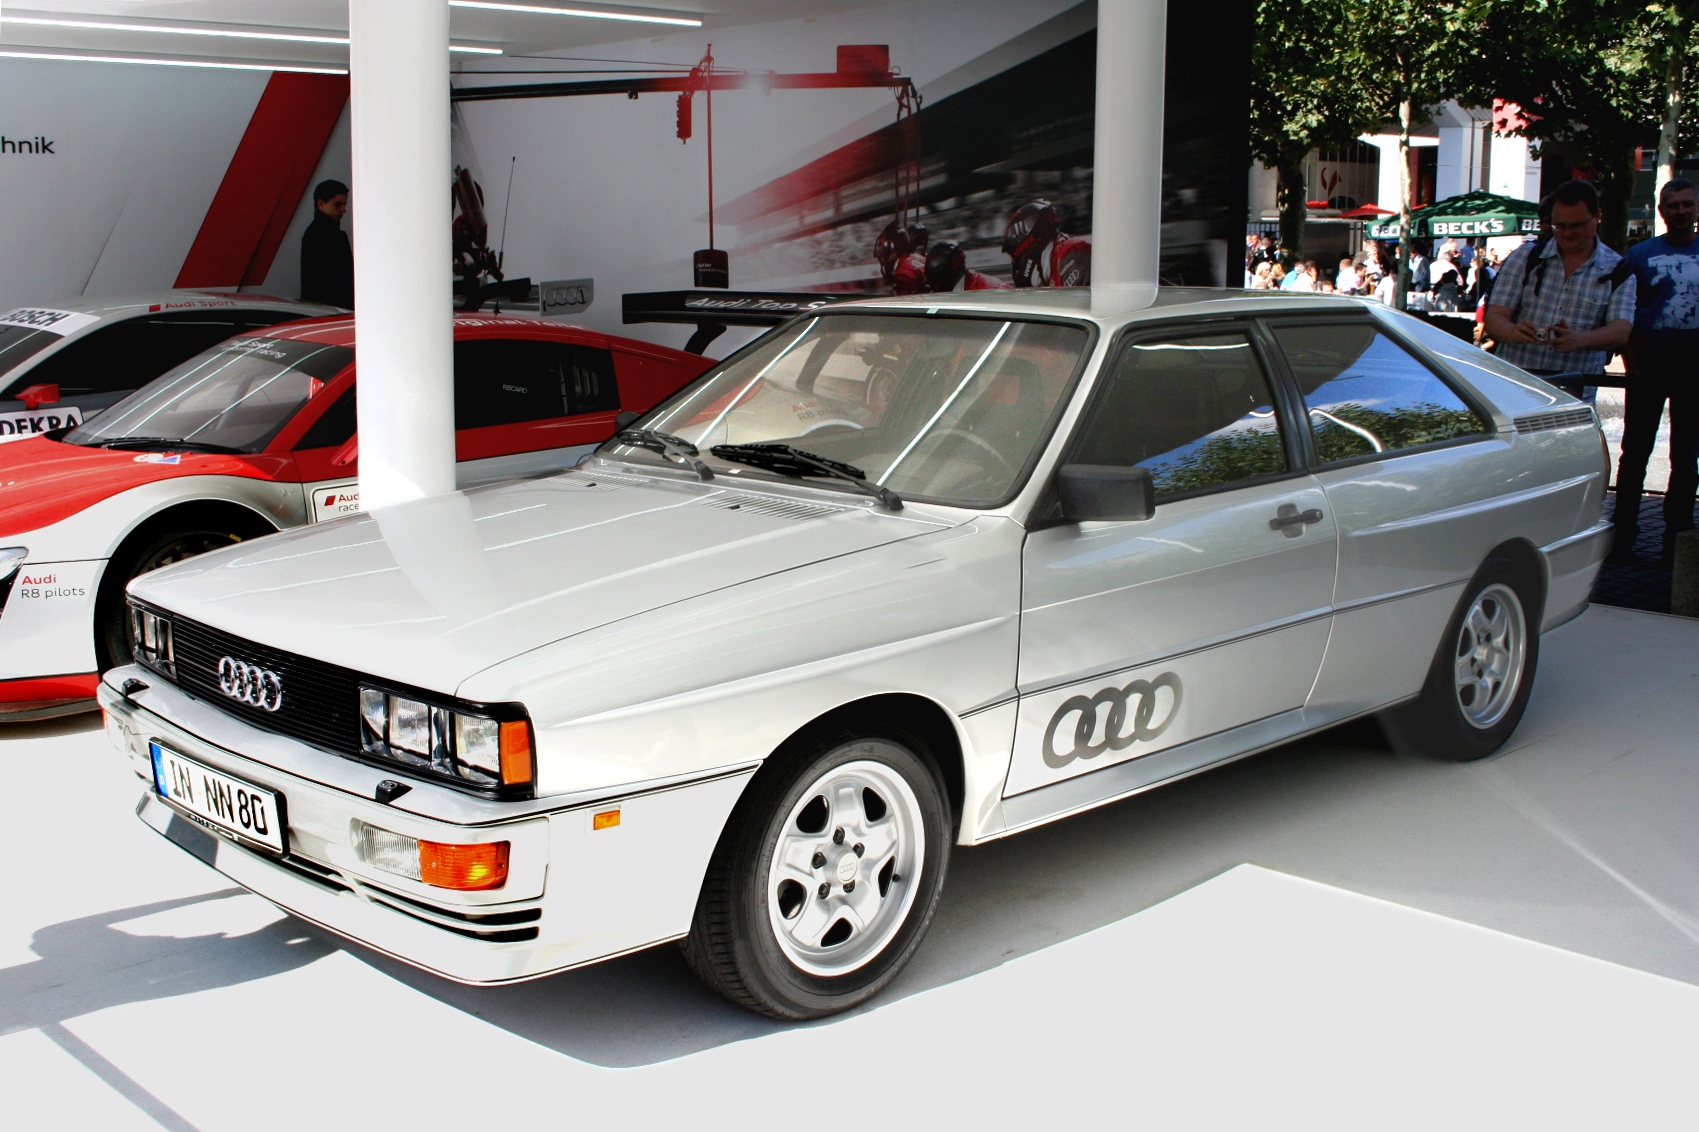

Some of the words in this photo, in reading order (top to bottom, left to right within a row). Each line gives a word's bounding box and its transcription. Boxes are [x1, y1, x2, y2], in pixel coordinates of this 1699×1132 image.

[1, 135, 56, 155] hnik
[1433, 218, 1504, 235] BECK'S
[165, 301, 196, 309] Audi
[198, 300, 238, 308] Sport
[686, 298, 752, 308] Audi
[751, 299, 798, 310] Top
[0, 413, 79, 436] DEKRA
[21, 573, 57, 585] Audi
[21, 588, 41, 599] R8
[45, 587, 86, 599] pilots
[169, 759, 194, 804] IN
